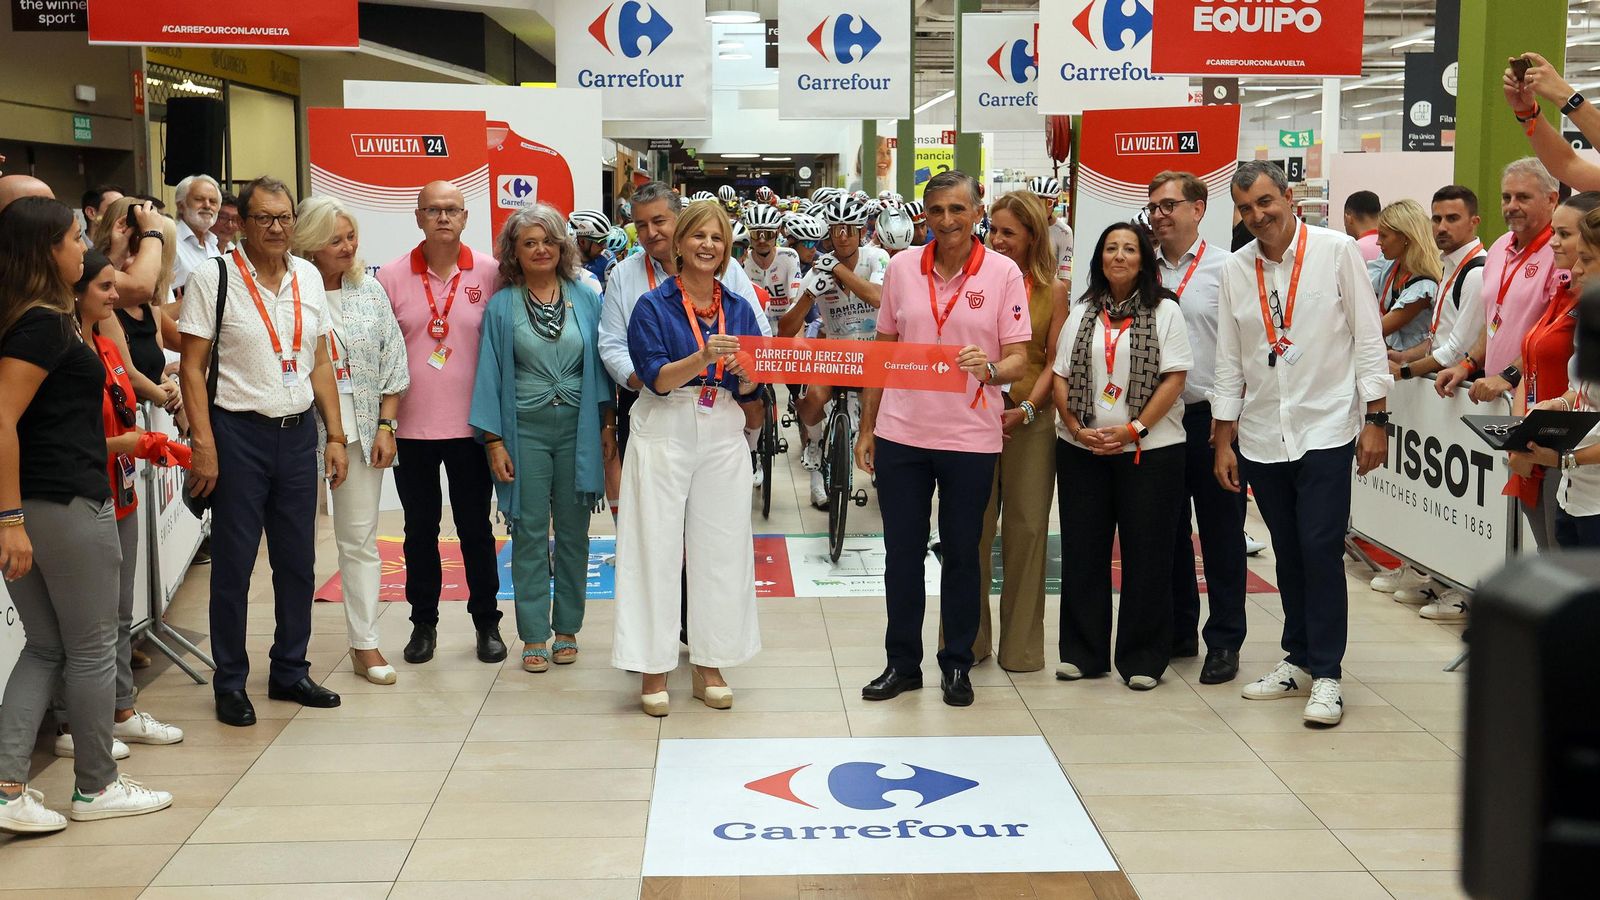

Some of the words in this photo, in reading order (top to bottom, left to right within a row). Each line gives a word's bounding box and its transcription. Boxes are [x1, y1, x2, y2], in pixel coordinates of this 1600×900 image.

[20, 0, 43, 10] the
[46, 0, 87, 10] winne
[38, 13, 76, 26] sport
[1193, 6, 1322, 33] EQUIPO
[162, 25, 290, 36] #CARREFOURCONLAVUELTA
[768, 27, 778, 36] re
[1205, 58, 1306, 67] #CARREFOURCONLAVUELTA
[578, 69, 685, 88] Carrefour
[1060, 62, 1165, 81] Carrefou
[797, 73, 891, 91] Carrefour
[359, 138, 374, 152] LA
[375, 138, 420, 152] VUELTA
[427, 139, 443, 153] 24
[1121, 137, 1134, 151] LA
[1135, 136, 1174, 151] VUELTA
[1180, 135, 1195, 150] 24
[1291, 162, 1298, 177] 5
[755, 348, 812, 361] CARREFOUR
[814, 350, 842, 363] JEREZ
[844, 351, 864, 364] SUR
[754, 361, 782, 372] JEREZ
[785, 361, 797, 372] DE
[800, 362, 811, 373] LA
[813, 362, 864, 375] FRONTERA
[884, 361, 929, 371] Carrefour
[1382, 422, 1494, 508] TISSOT
[1371, 474, 1417, 508] WATCHES
[1423, 497, 1457, 525] SINCE
[1464, 514, 1493, 540] 1853
[713, 820, 1029, 840] Carrefour
